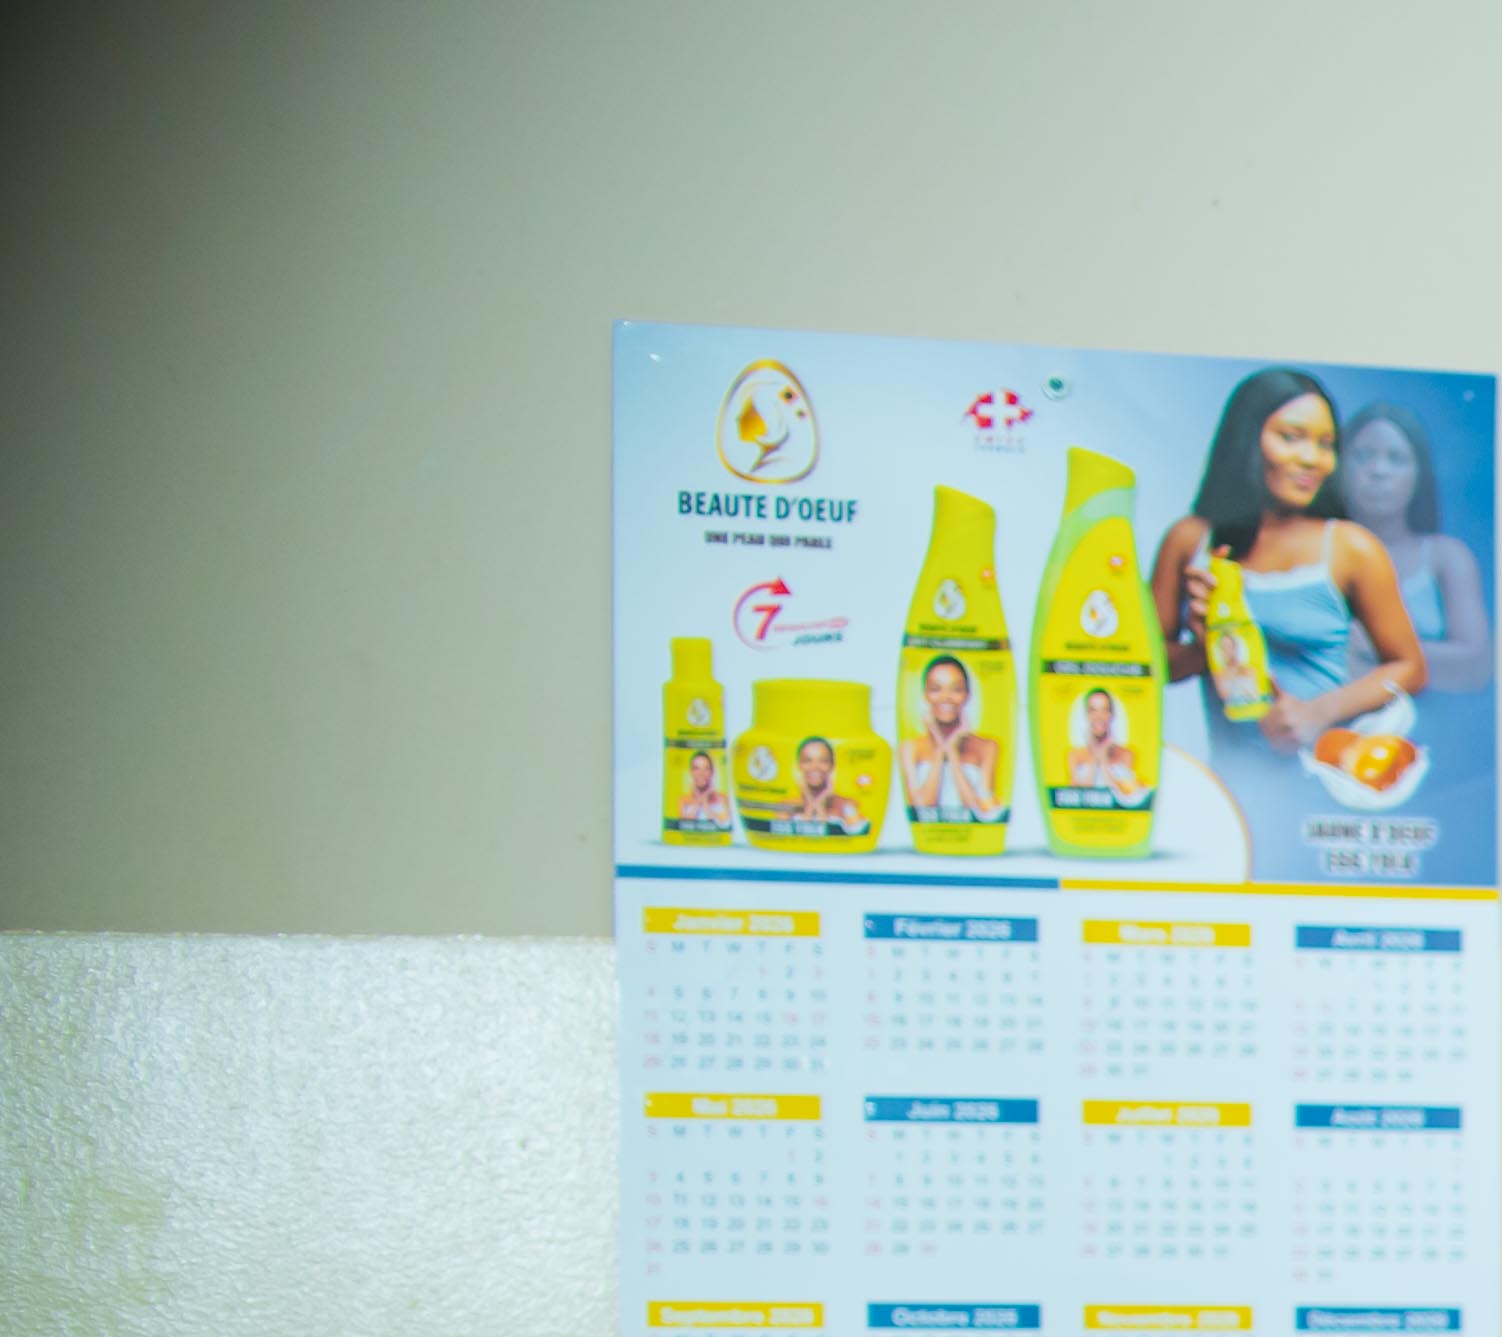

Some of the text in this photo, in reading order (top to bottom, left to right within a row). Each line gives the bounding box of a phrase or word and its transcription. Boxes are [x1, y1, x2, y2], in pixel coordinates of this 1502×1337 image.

[678, 490, 858, 522] BEAUTE D'OEUF
[752, 604, 782, 640] 7
